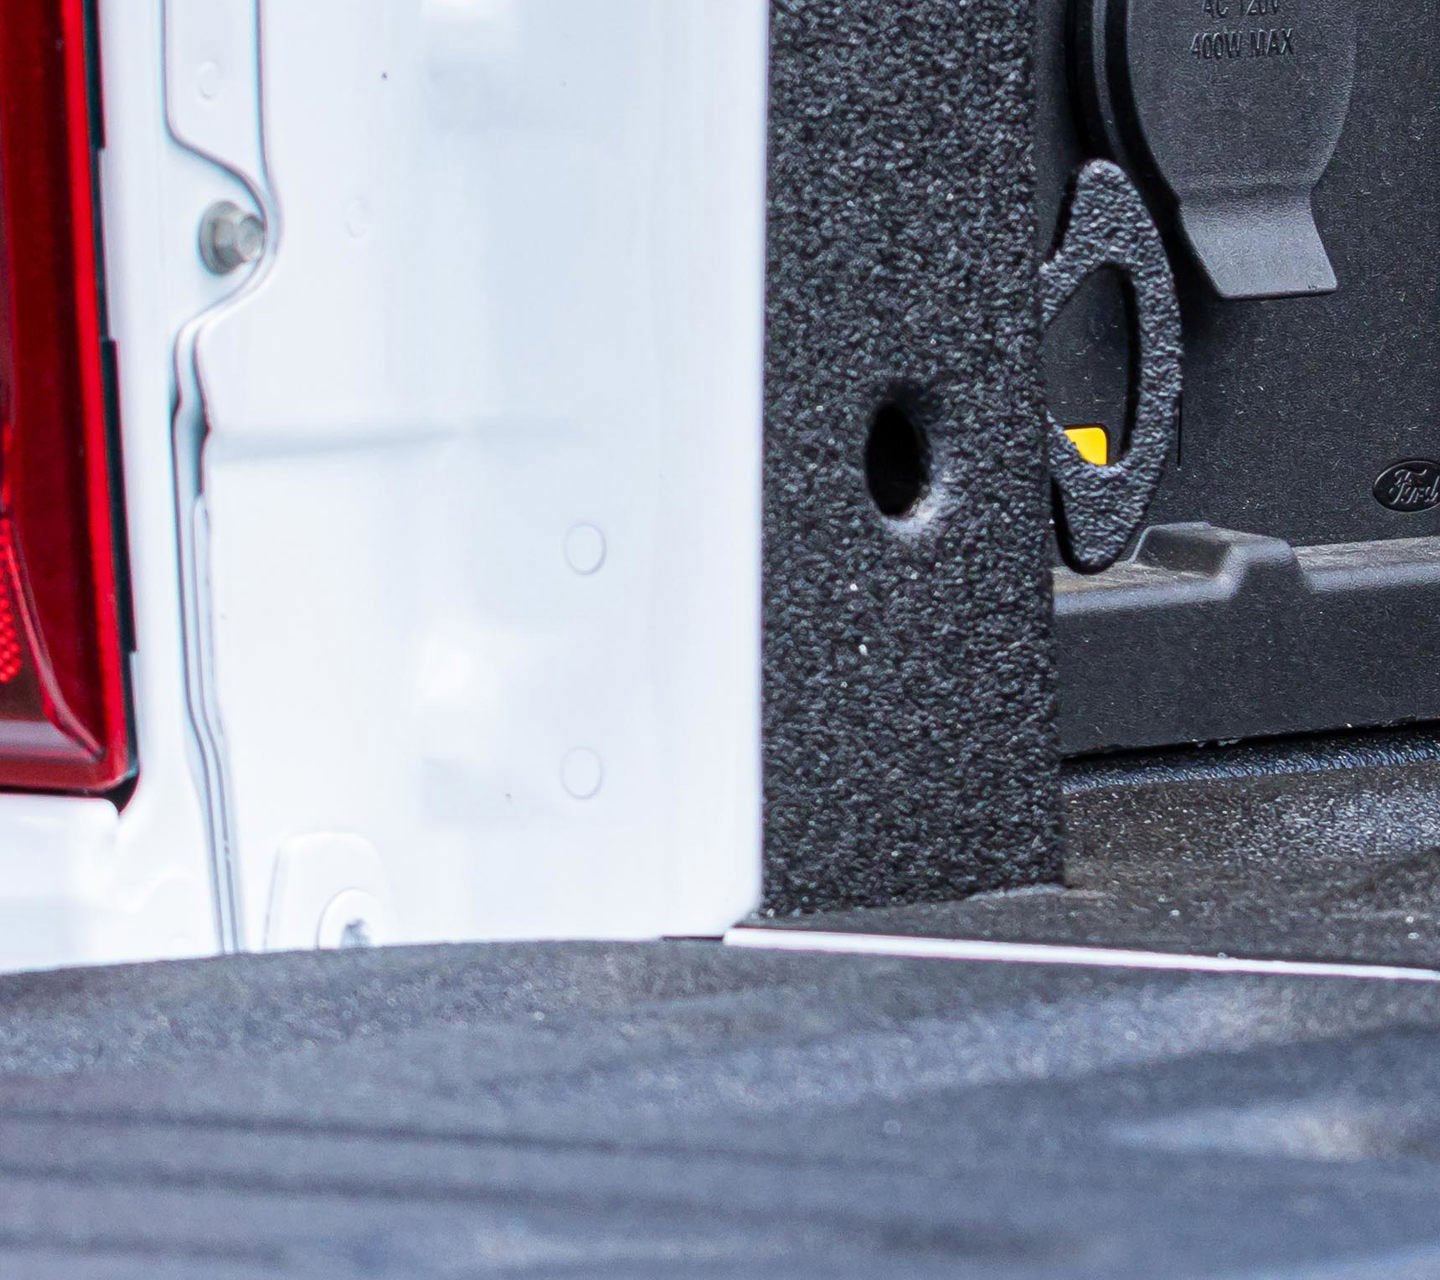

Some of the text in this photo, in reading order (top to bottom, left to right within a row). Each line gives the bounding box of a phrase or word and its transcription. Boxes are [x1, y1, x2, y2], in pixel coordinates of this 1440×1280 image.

[1189, 27, 1296, 60] 400W MAX
[1388, 468, 1440, 506] Ford
